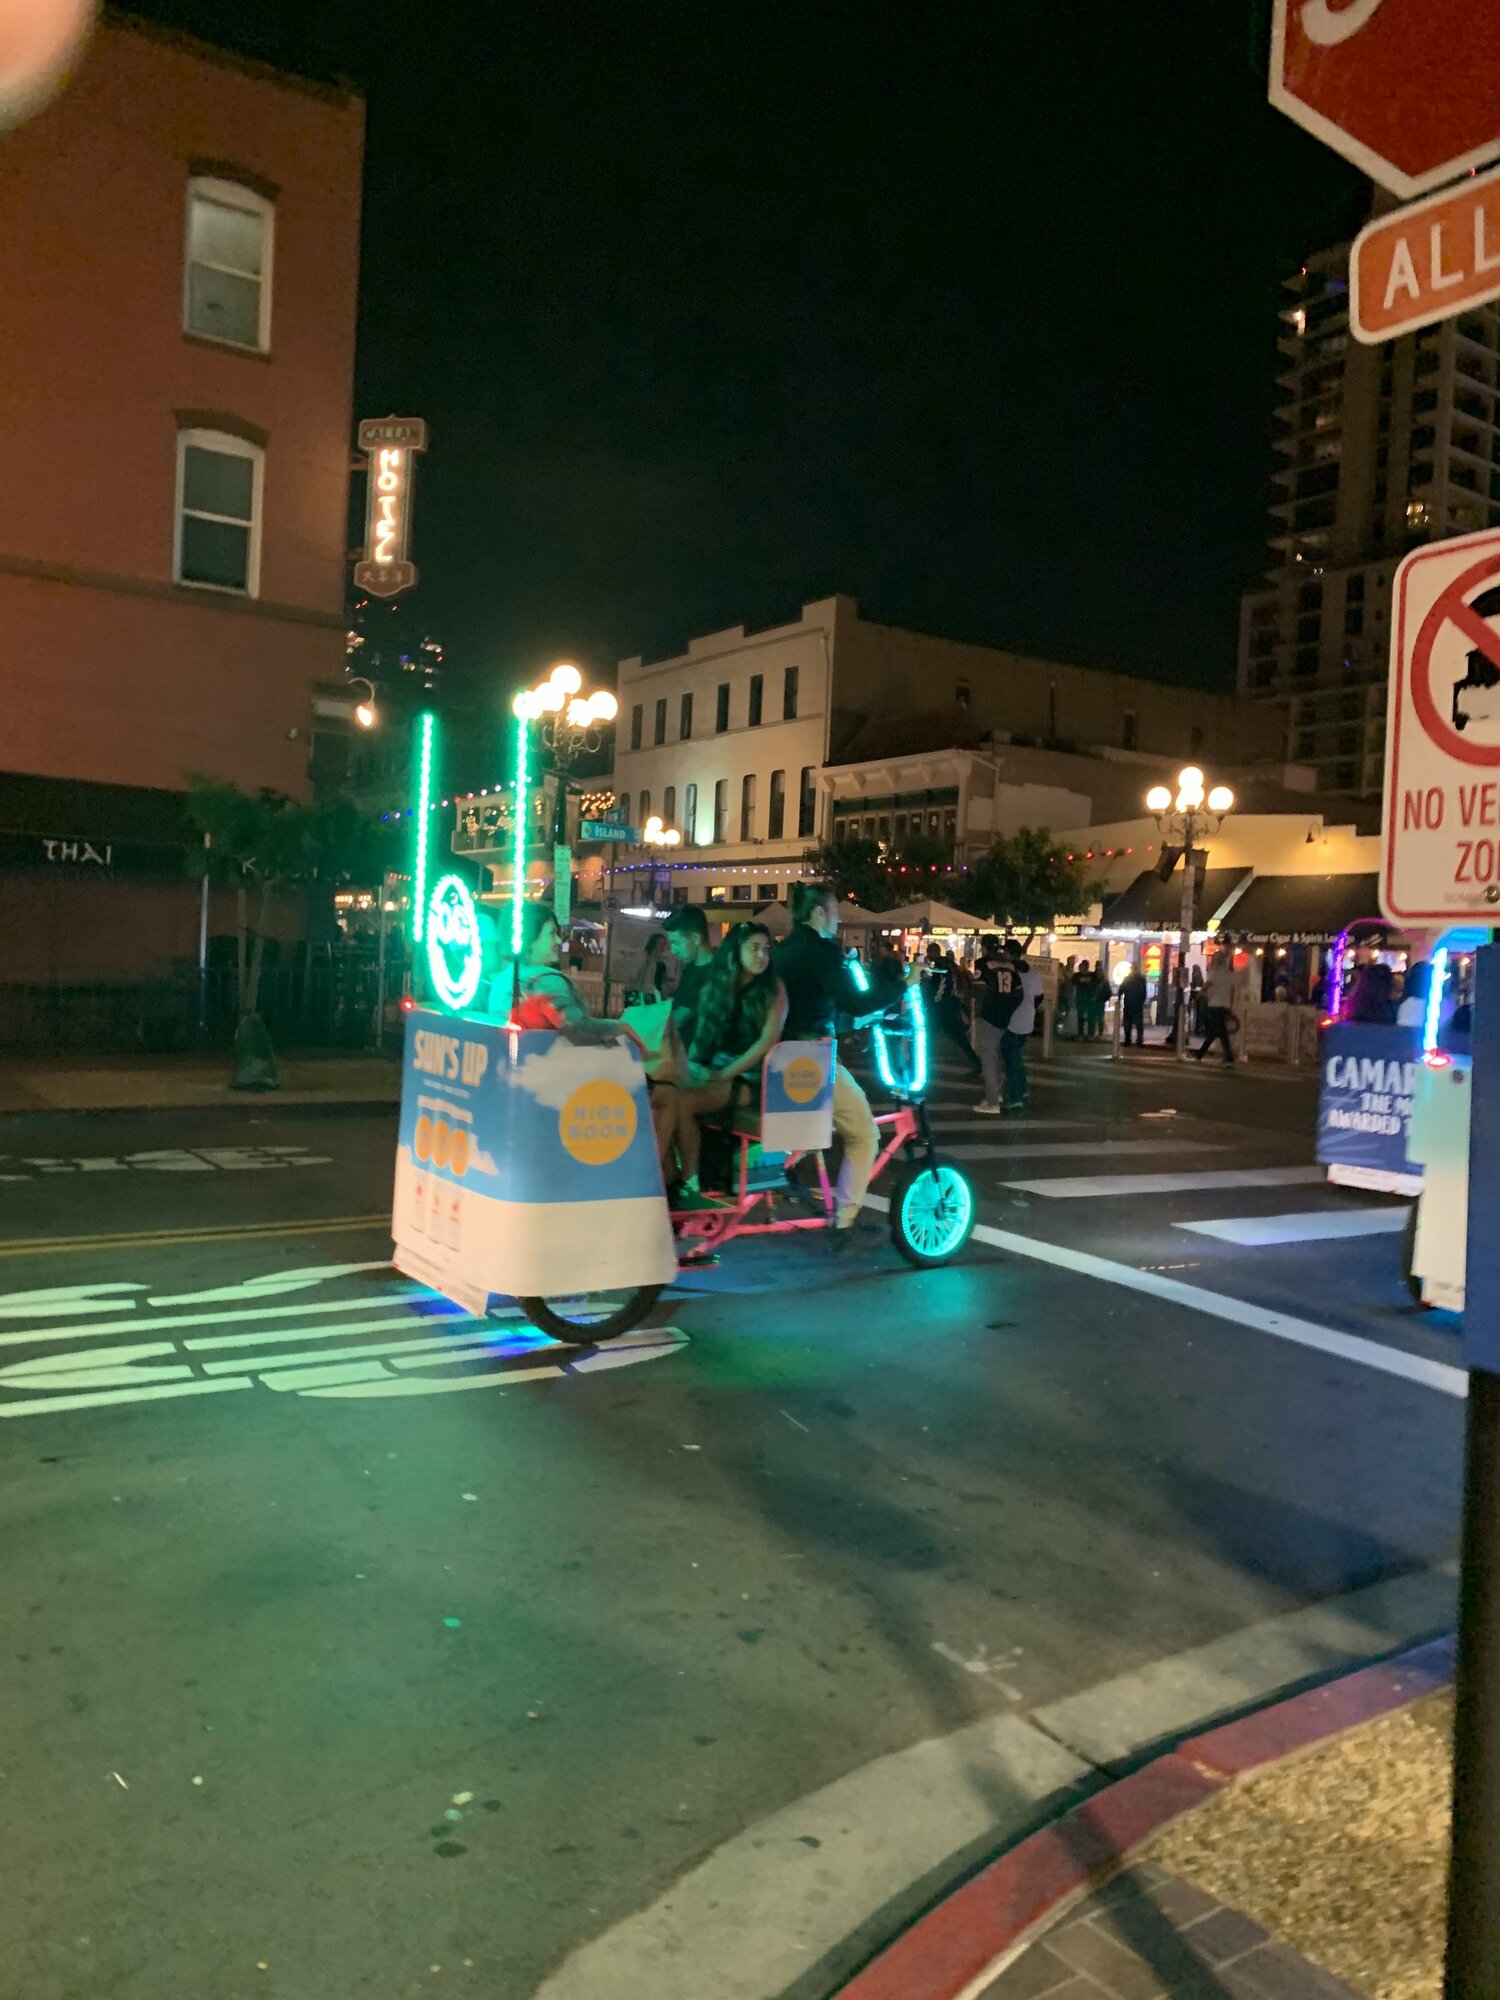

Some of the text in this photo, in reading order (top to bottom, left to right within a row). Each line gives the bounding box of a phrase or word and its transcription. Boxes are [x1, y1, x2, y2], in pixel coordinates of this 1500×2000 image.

[1383, 206, 1500, 310] ALL
[374, 448, 400, 564] HOTEL
[1403, 782, 1500, 831] NO VE
[42, 839, 112, 865] THAI
[594, 825, 626, 839] ISLAND
[1454, 839, 1500, 883] ZO
[461, 1041, 488, 1087] UP
[567, 1123, 628, 1140] NOON
[575, 1105, 625, 1120] HIGH
